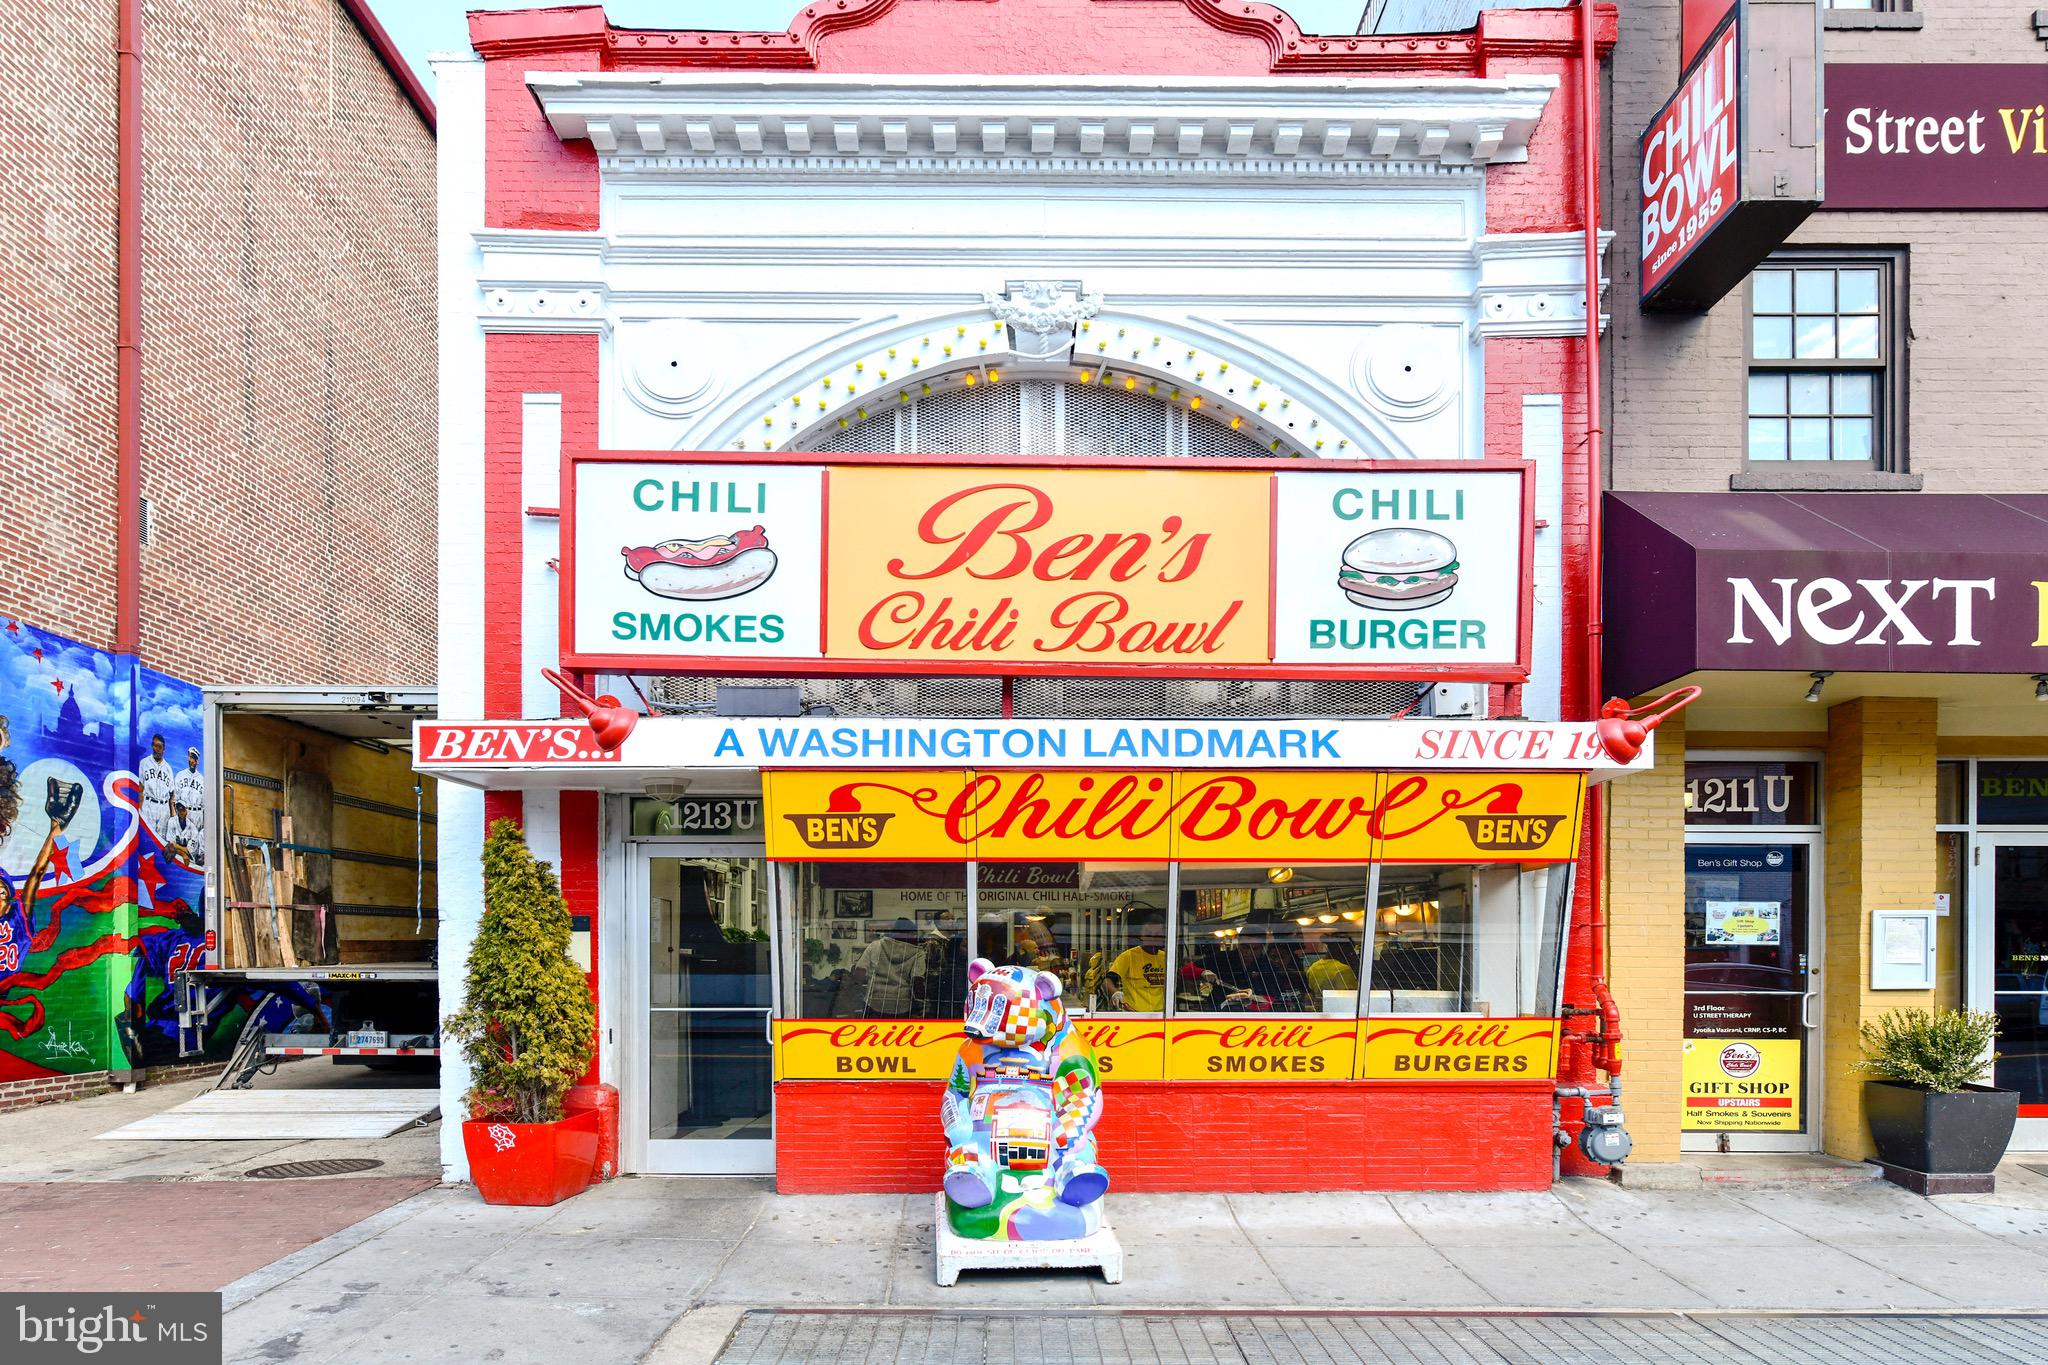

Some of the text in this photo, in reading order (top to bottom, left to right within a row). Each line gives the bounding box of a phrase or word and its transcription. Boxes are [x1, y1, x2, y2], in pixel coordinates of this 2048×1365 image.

[1642, 37, 1735, 198] CHILI
[1846, 104, 2048, 155] Street Vi
[1642, 113, 1736, 261] BOWL
[1652, 187, 1722, 274] since 1958
[632, 478, 766, 514] CHILI
[1332, 487, 1464, 521] CHILI
[887, 483, 1211, 582] Ben's
[611, 610, 785, 644] SMOKES
[858, 590, 1243, 655] Chili Bowl
[1309, 618, 1486, 650] BURGER
[714, 728, 1341, 760] A WASHINGTON LANDMARK
[1415, 729, 1553, 760] SINCE
[144, 768, 170, 788] GRAYS
[179, 777, 204, 795] GRAYS
[1687, 775, 1794, 813] 1211 U
[671, 802, 732, 830] 1213
[944, 773, 1437, 845] Chili Bowl
[806, 817, 879, 844] BEN'S
[1476, 818, 1548, 844] BEN'S
[977, 865, 1075, 885] Chili Bowl
[1697, 859, 1763, 869] Ben's Gift Shop
[900, 891, 932, 902] HOME
[937, 891, 950, 901] OF
[955, 891, 968, 901] TH
[979, 890, 1030, 902] ORIGINAL
[1033, 890, 1060, 901] CHILI
[830, 1024, 925, 1048] Chili
[1219, 1024, 1315, 1048] Chili
[1414, 1024, 1511, 1048] Chili
[836, 1056, 917, 1073] BOWL
[1207, 1055, 1326, 1073] SMOKES
[1394, 1055, 1528, 1073] BURGERS
[1723, 1048, 1752, 1059] Ben's
[1689, 1082, 1790, 1094] GIFT SHOP
[1718, 1098, 1760, 1107] UPSTAIRS
